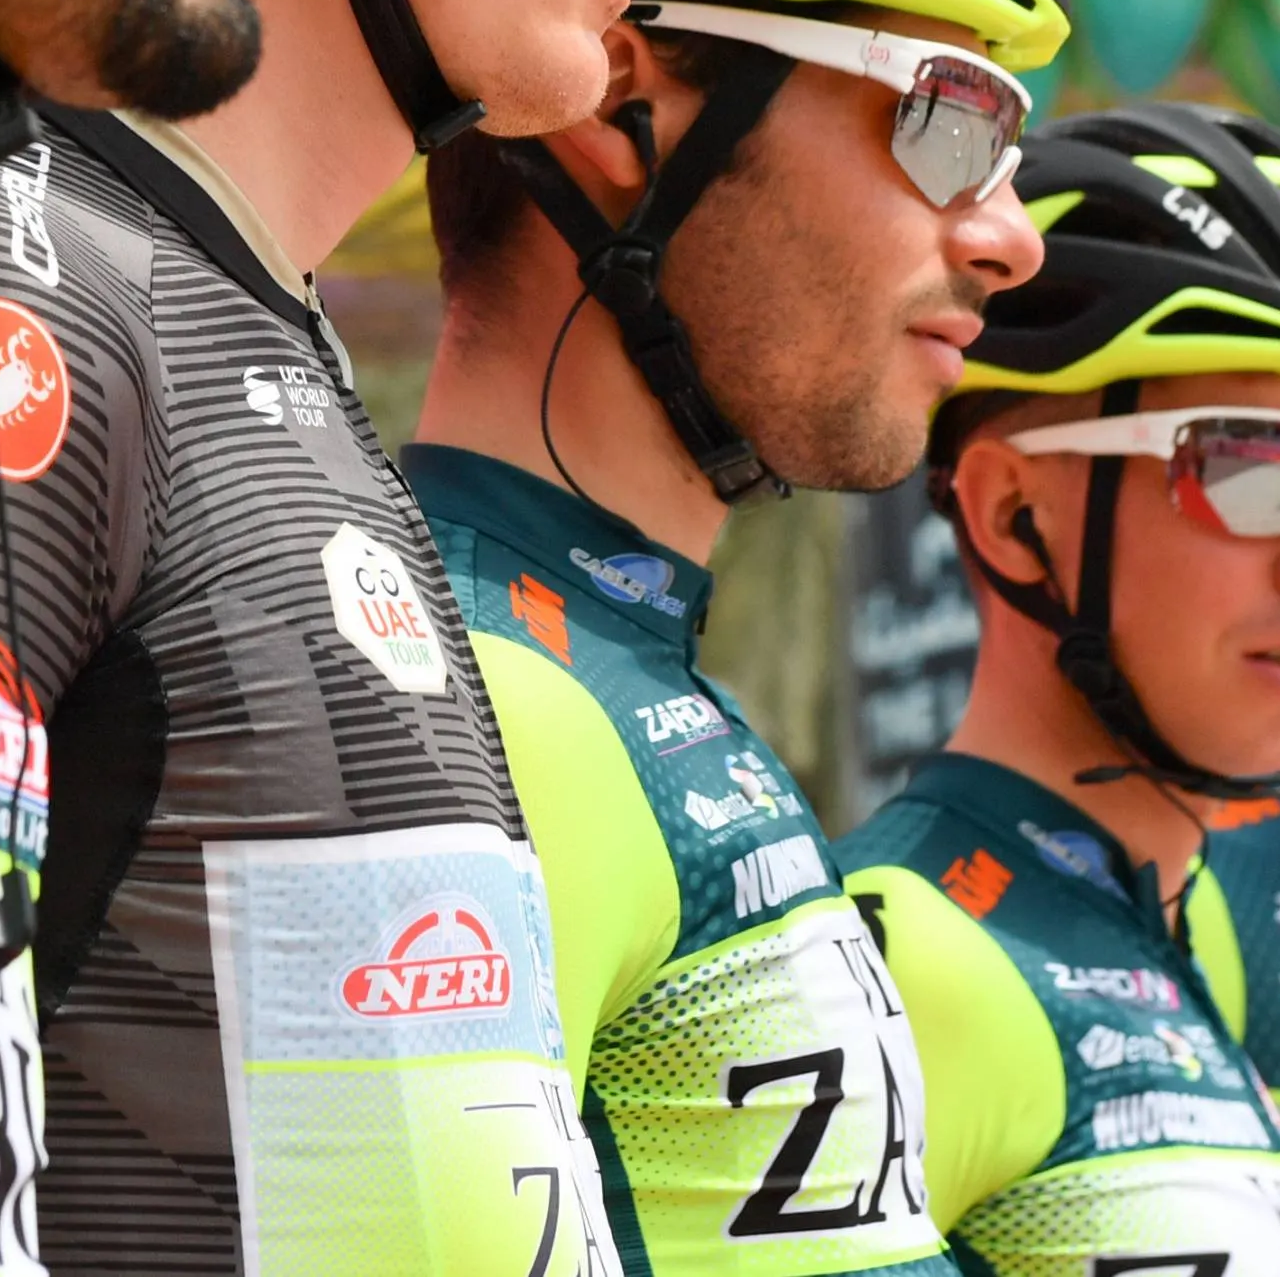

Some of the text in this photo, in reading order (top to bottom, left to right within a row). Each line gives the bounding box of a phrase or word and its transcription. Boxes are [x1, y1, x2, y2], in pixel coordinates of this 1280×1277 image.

[278, 365, 308, 385] UCI
[285, 386, 329, 407] WORLD
[293, 407, 327, 428] TOUR
[358, 599, 427, 639] UAE
[385, 641, 434, 667] TOUR
[356, 958, 505, 1012] NERI
